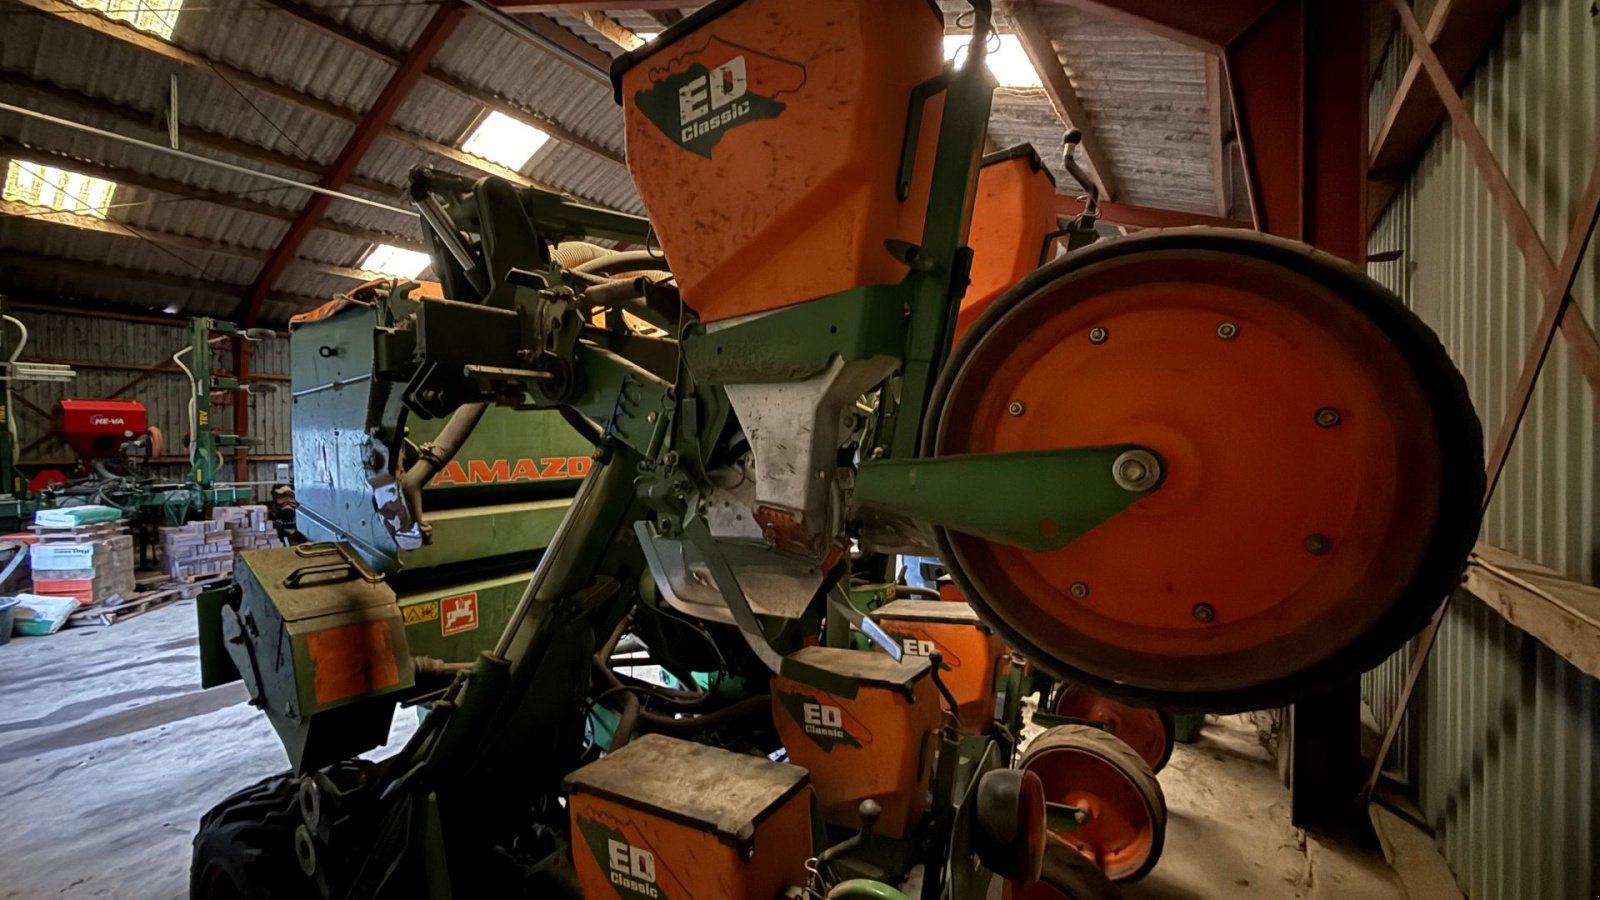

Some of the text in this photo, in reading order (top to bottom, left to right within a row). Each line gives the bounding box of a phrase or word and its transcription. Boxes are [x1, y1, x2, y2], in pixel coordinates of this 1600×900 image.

[678, 55, 748, 127] ED
[681, 100, 751, 144] Classic
[94, 417, 125, 425] HE-VA
[902, 638, 936, 657] ED
[802, 702, 843, 729] ED
[804, 724, 845, 738] Classic
[607, 838, 657, 884] ED
[610, 870, 659, 900] Classic
